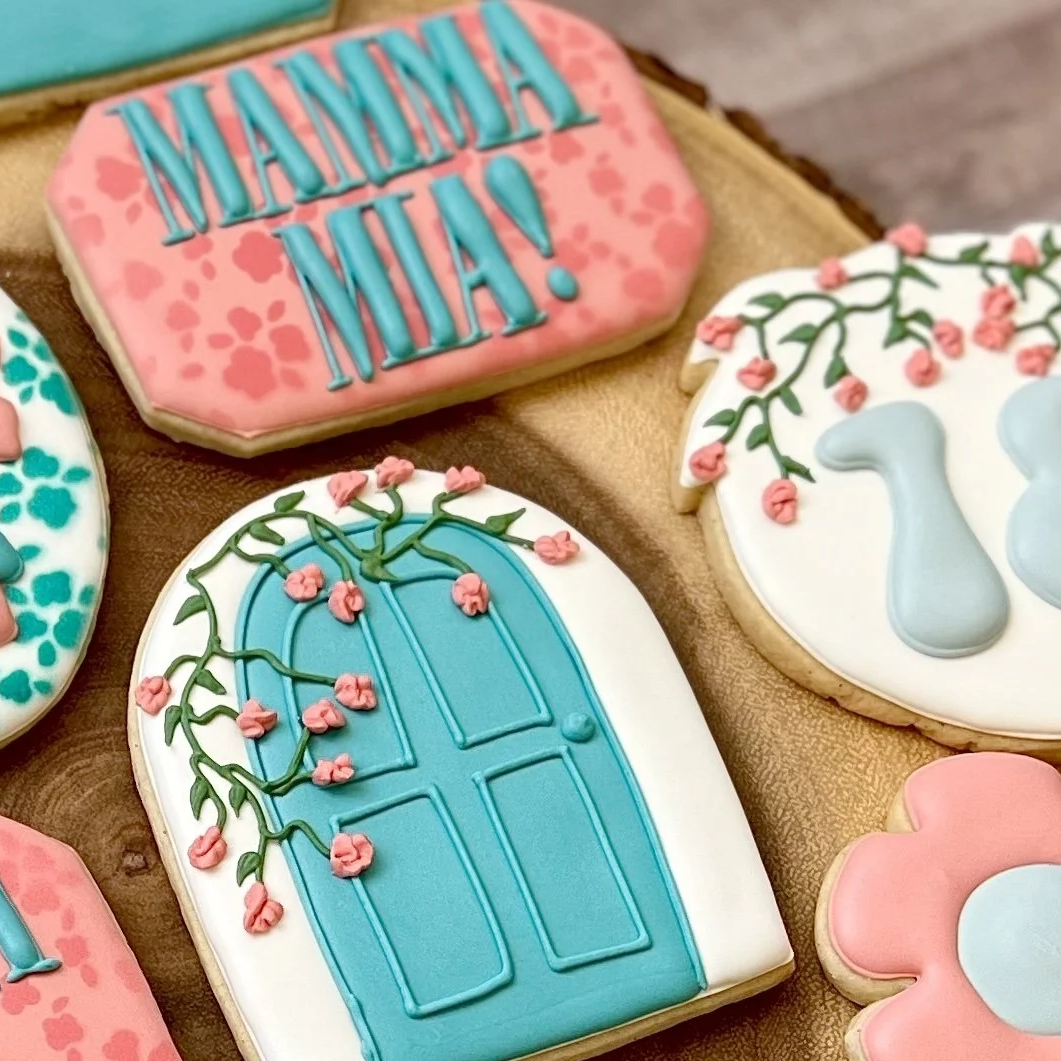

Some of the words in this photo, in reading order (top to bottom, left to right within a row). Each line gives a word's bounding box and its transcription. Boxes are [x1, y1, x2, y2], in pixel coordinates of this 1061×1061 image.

[105, 0, 600, 246] MAMMA
[273, 154, 579, 391] MIA!
[815, 376, 1061, 659] 1
